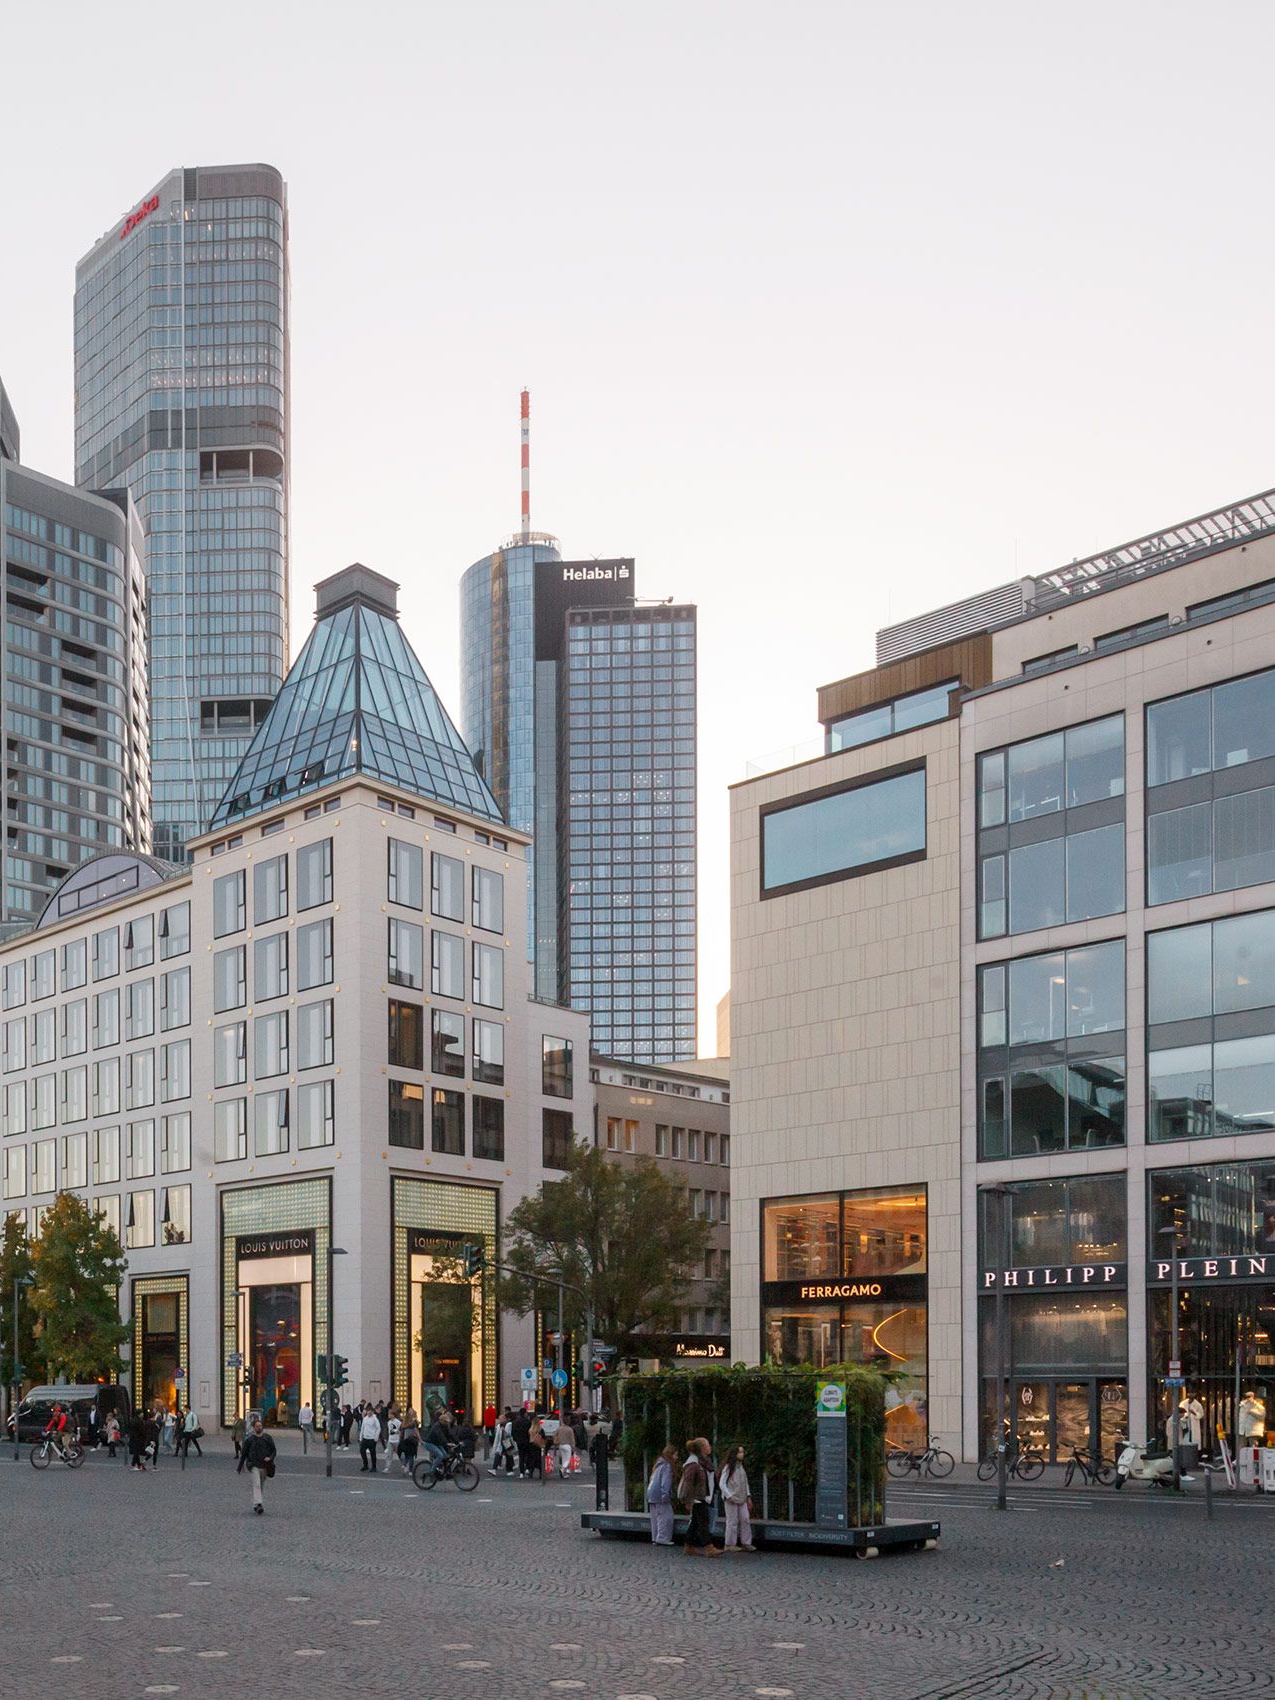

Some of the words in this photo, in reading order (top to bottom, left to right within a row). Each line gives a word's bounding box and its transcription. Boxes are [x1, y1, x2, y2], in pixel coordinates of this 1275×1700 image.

[563, 566, 613, 581] Helaba
[240, 1241, 267, 1254] LOUIS
[269, 1238, 309, 1251] VUITTON
[984, 1266, 1116, 1287] PHILIPP
[1157, 1257, 1267, 1279] PLEIN
[801, 1283, 882, 1298] FERRAGAMO
